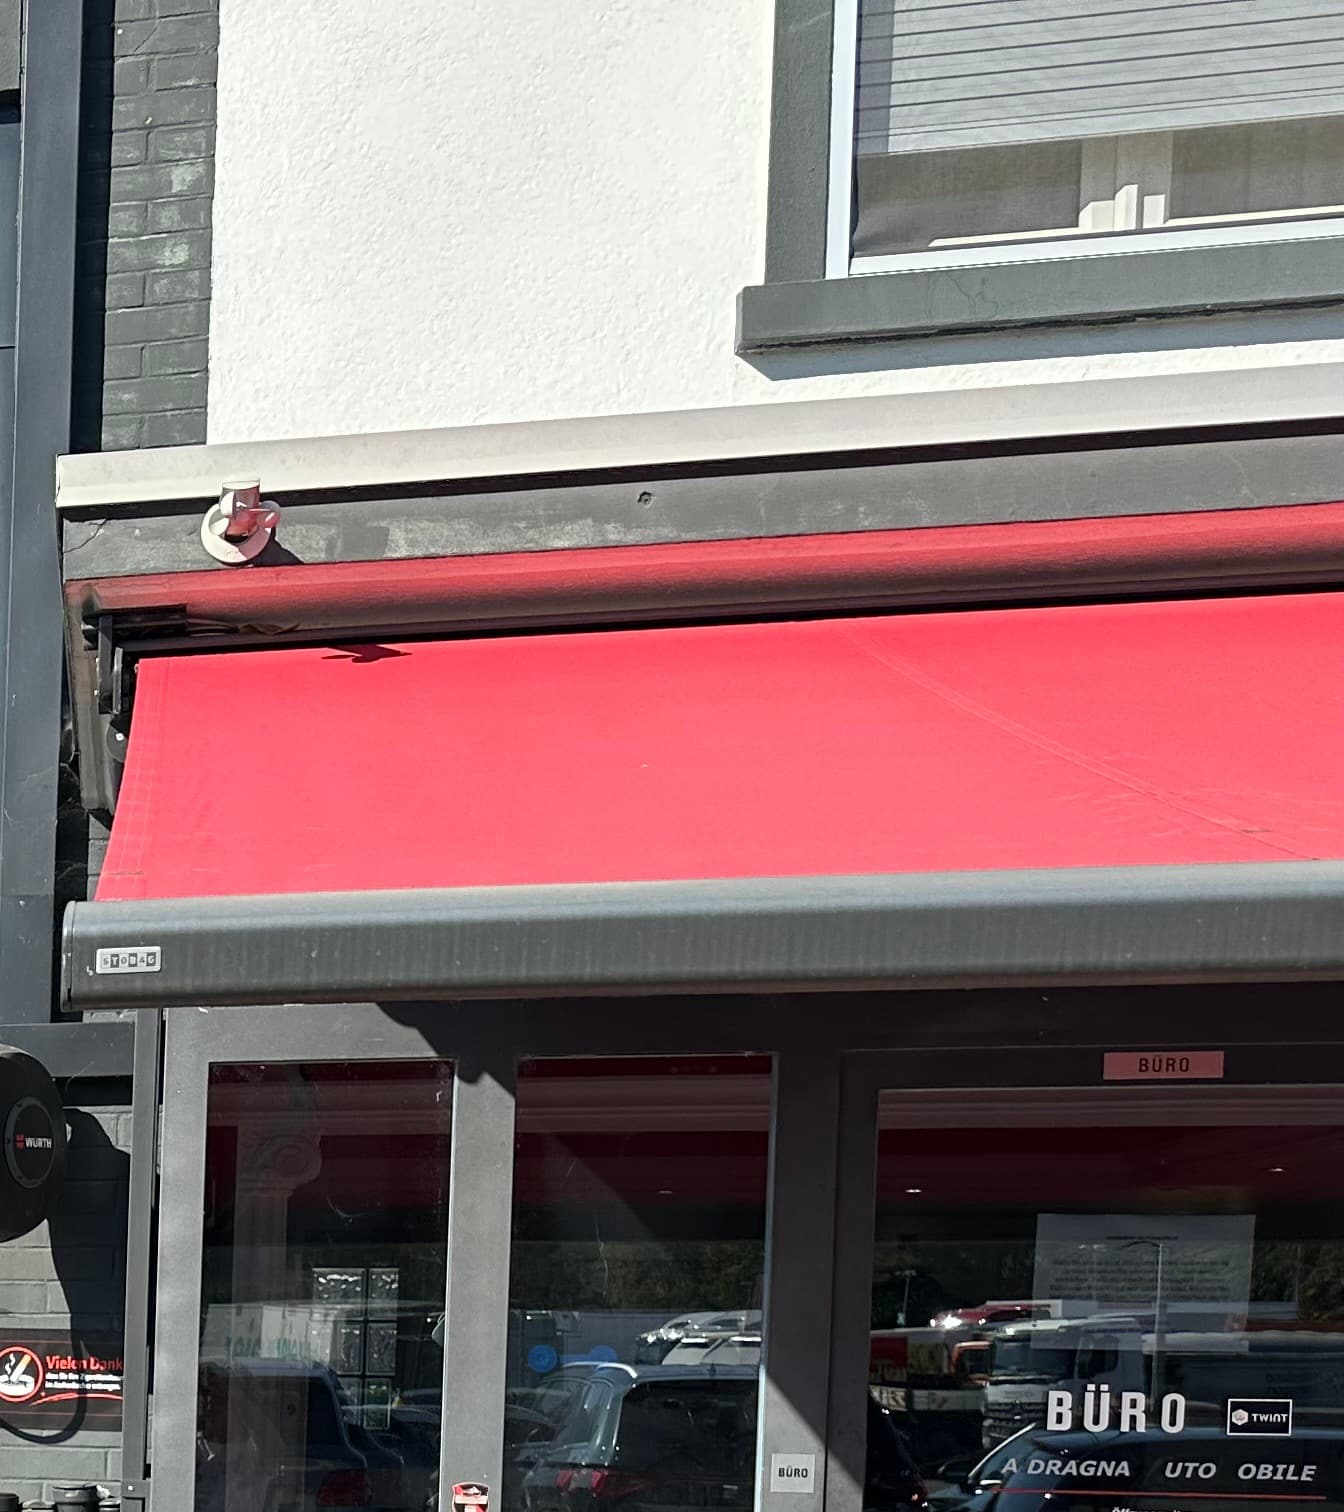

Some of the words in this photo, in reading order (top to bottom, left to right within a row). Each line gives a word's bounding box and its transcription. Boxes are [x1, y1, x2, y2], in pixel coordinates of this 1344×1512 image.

[1138, 1055, 1190, 1073] BÜRO
[1046, 1383, 1186, 1434] BÜRO
[1251, 1413, 1288, 1424] TWINT
[778, 1465, 808, 1478] BÜRO
[1164, 1461, 1217, 1479] UTO
[1237, 1463, 1317, 1481] OBILE
